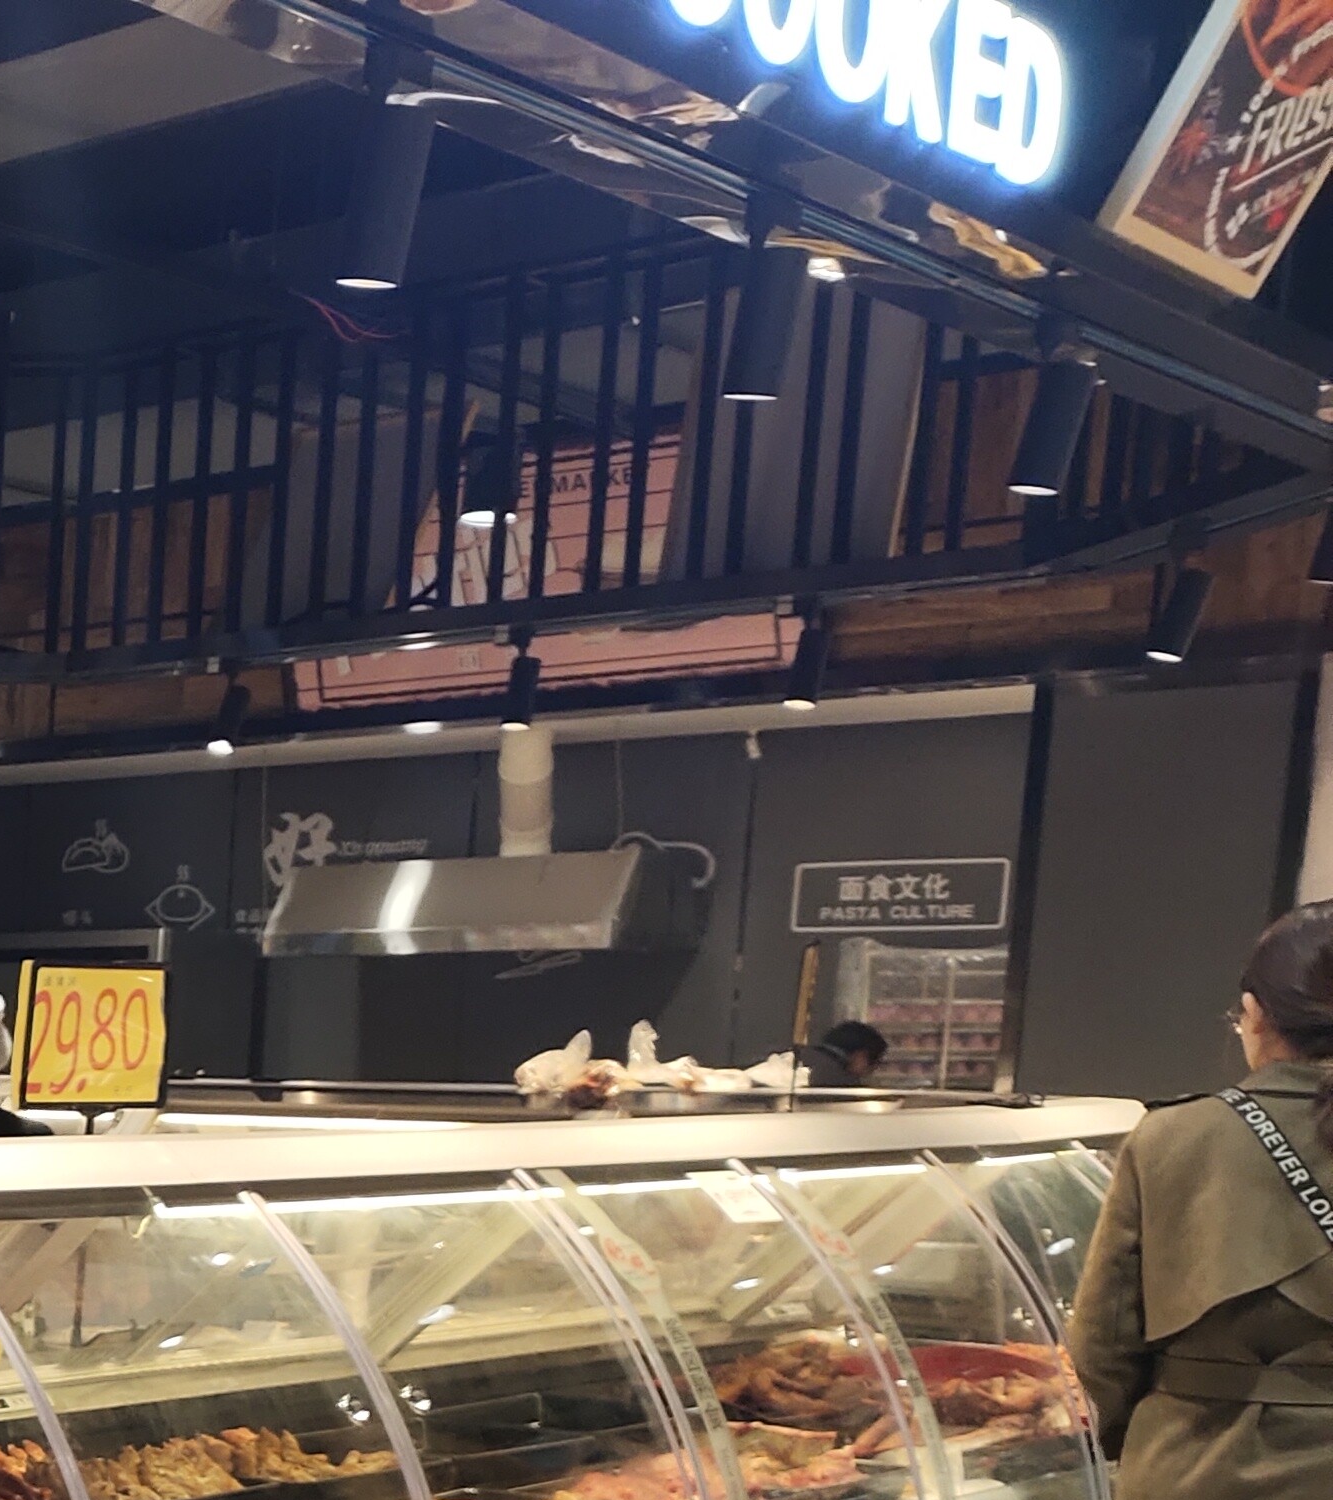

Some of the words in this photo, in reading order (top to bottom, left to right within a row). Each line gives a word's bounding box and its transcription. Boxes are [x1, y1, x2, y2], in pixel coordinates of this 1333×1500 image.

[668, 0, 1063, 185] OKED
[819, 906, 881, 921] PASTA
[889, 904, 975, 919] CULTURE
[1237, 1101, 1310, 1186] FOREVER
